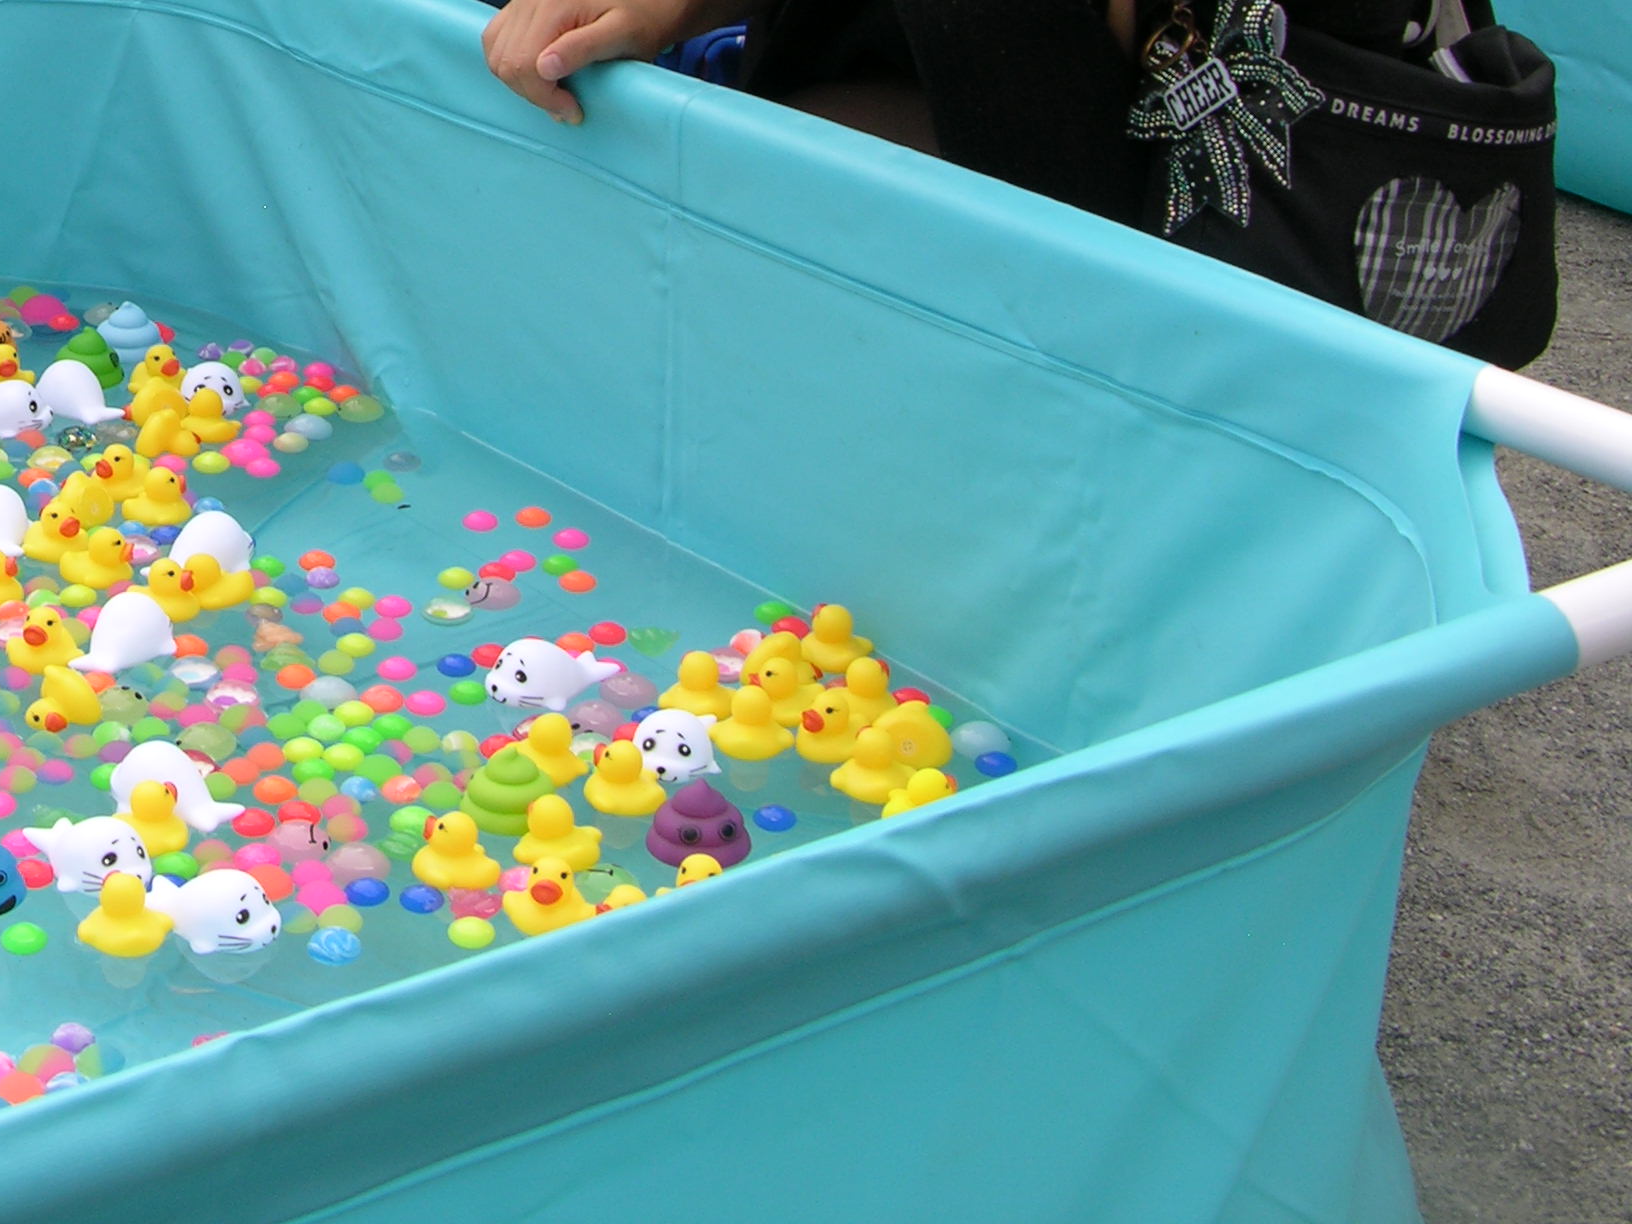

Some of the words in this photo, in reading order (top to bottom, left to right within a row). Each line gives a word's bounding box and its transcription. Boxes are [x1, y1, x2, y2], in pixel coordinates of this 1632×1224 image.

[1167, 62, 1232, 127] CHEER
[1330, 97, 1420, 133] DREAMS
[1447, 123, 1543, 145] BLOSSOMING
